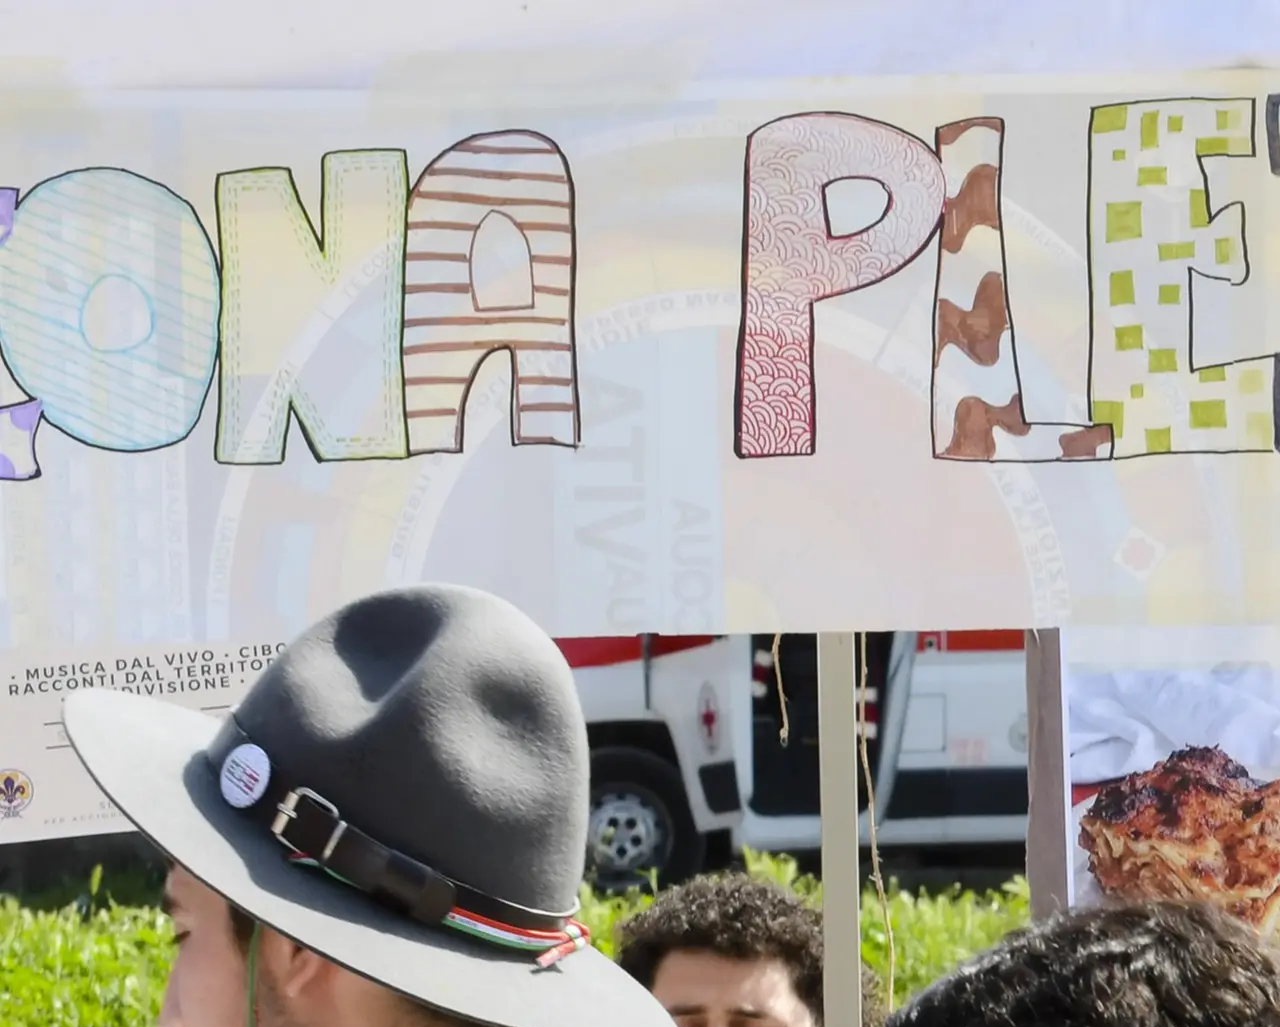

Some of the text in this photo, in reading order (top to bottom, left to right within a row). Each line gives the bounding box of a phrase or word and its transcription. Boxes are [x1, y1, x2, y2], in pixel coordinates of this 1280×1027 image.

[0, 128, 580, 480] ONA
[25, 661, 106, 681] MUSICA
[115, 656, 155, 671] DAL
[165, 650, 215, 666] VIVO
[8, 673, 115, 697] RACCONTI
[125, 669, 165, 685] DAL
